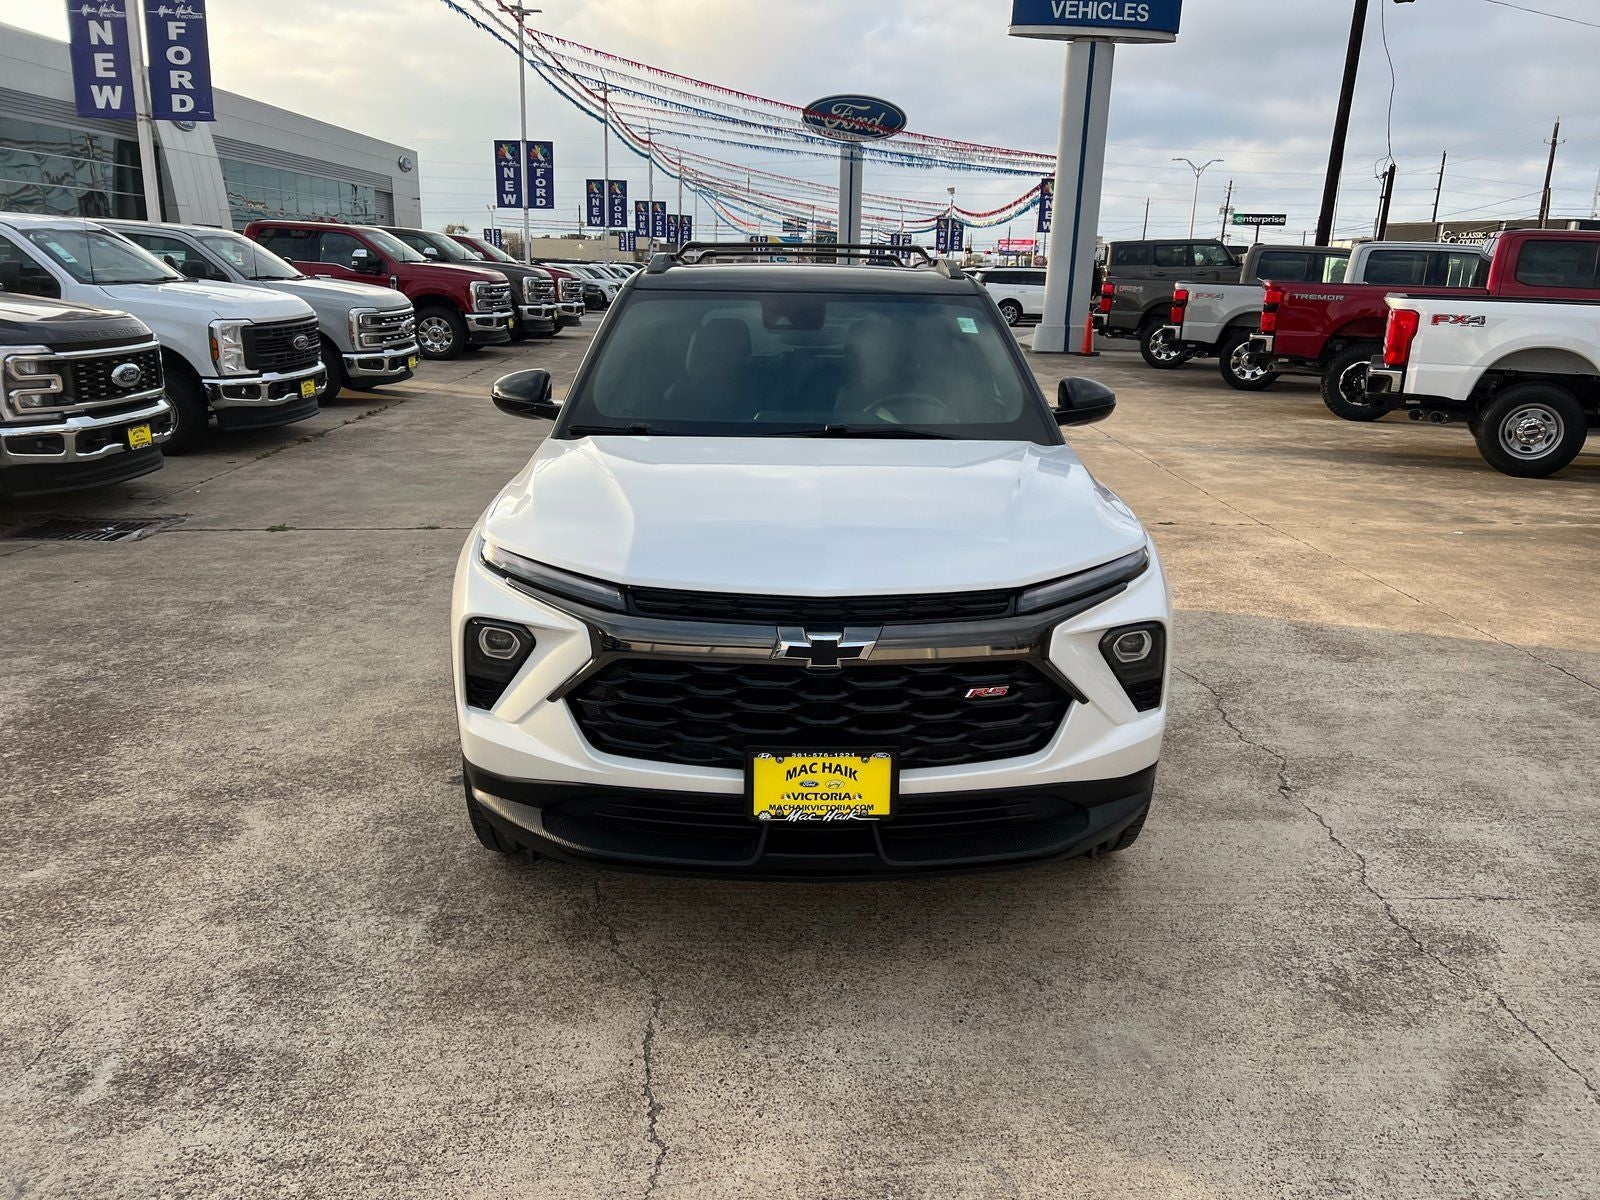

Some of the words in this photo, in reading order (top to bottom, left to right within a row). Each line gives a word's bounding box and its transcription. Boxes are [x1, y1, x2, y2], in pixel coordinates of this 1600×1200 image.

[1051, 1, 1149, 22] VEHICLES
[88, 20, 122, 110] NEW
[166, 21, 195, 113] FORD
[825, 102, 885, 132] Ford
[502, 167, 517, 205] NEW
[535, 168, 547, 206] FORD
[591, 198, 601, 225] NEW
[614, 198, 622, 226] FORD
[1236, 216, 1286, 225] enterprise
[639, 214, 647, 236] NEW
[1194, 292, 1224, 300] FX4
[1294, 293, 1345, 301] TREMOR
[1431, 314, 1486, 326] FX4
[964, 686, 1010, 698] RS
[785, 762, 818, 782] MAC
[821, 762, 859, 782] HAIK
[791, 792, 852, 801] VICTORIA
[785, 809, 817, 822] Mac
[822, 808, 861, 822] Haik
